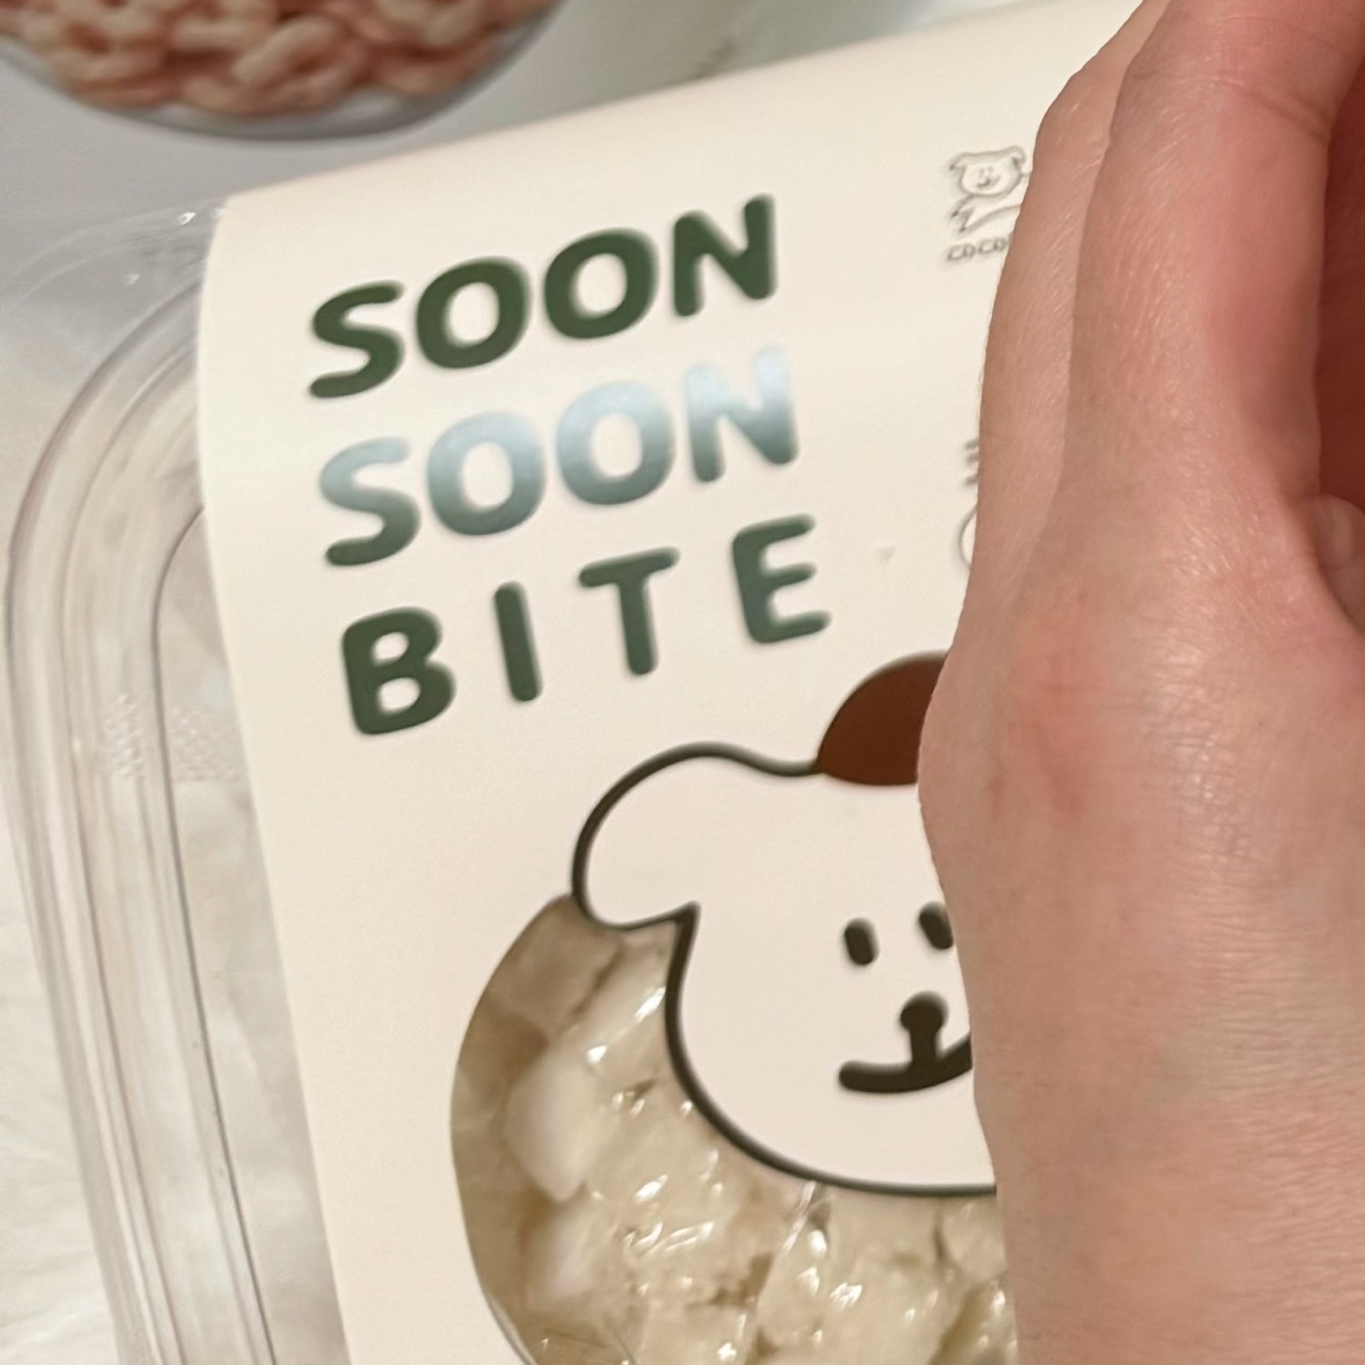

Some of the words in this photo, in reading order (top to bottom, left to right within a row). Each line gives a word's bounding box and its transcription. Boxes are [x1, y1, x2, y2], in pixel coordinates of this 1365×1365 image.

[309, 192, 778, 400] SOON
[318, 345, 800, 568] SOON
[340, 513, 833, 736] BITE
